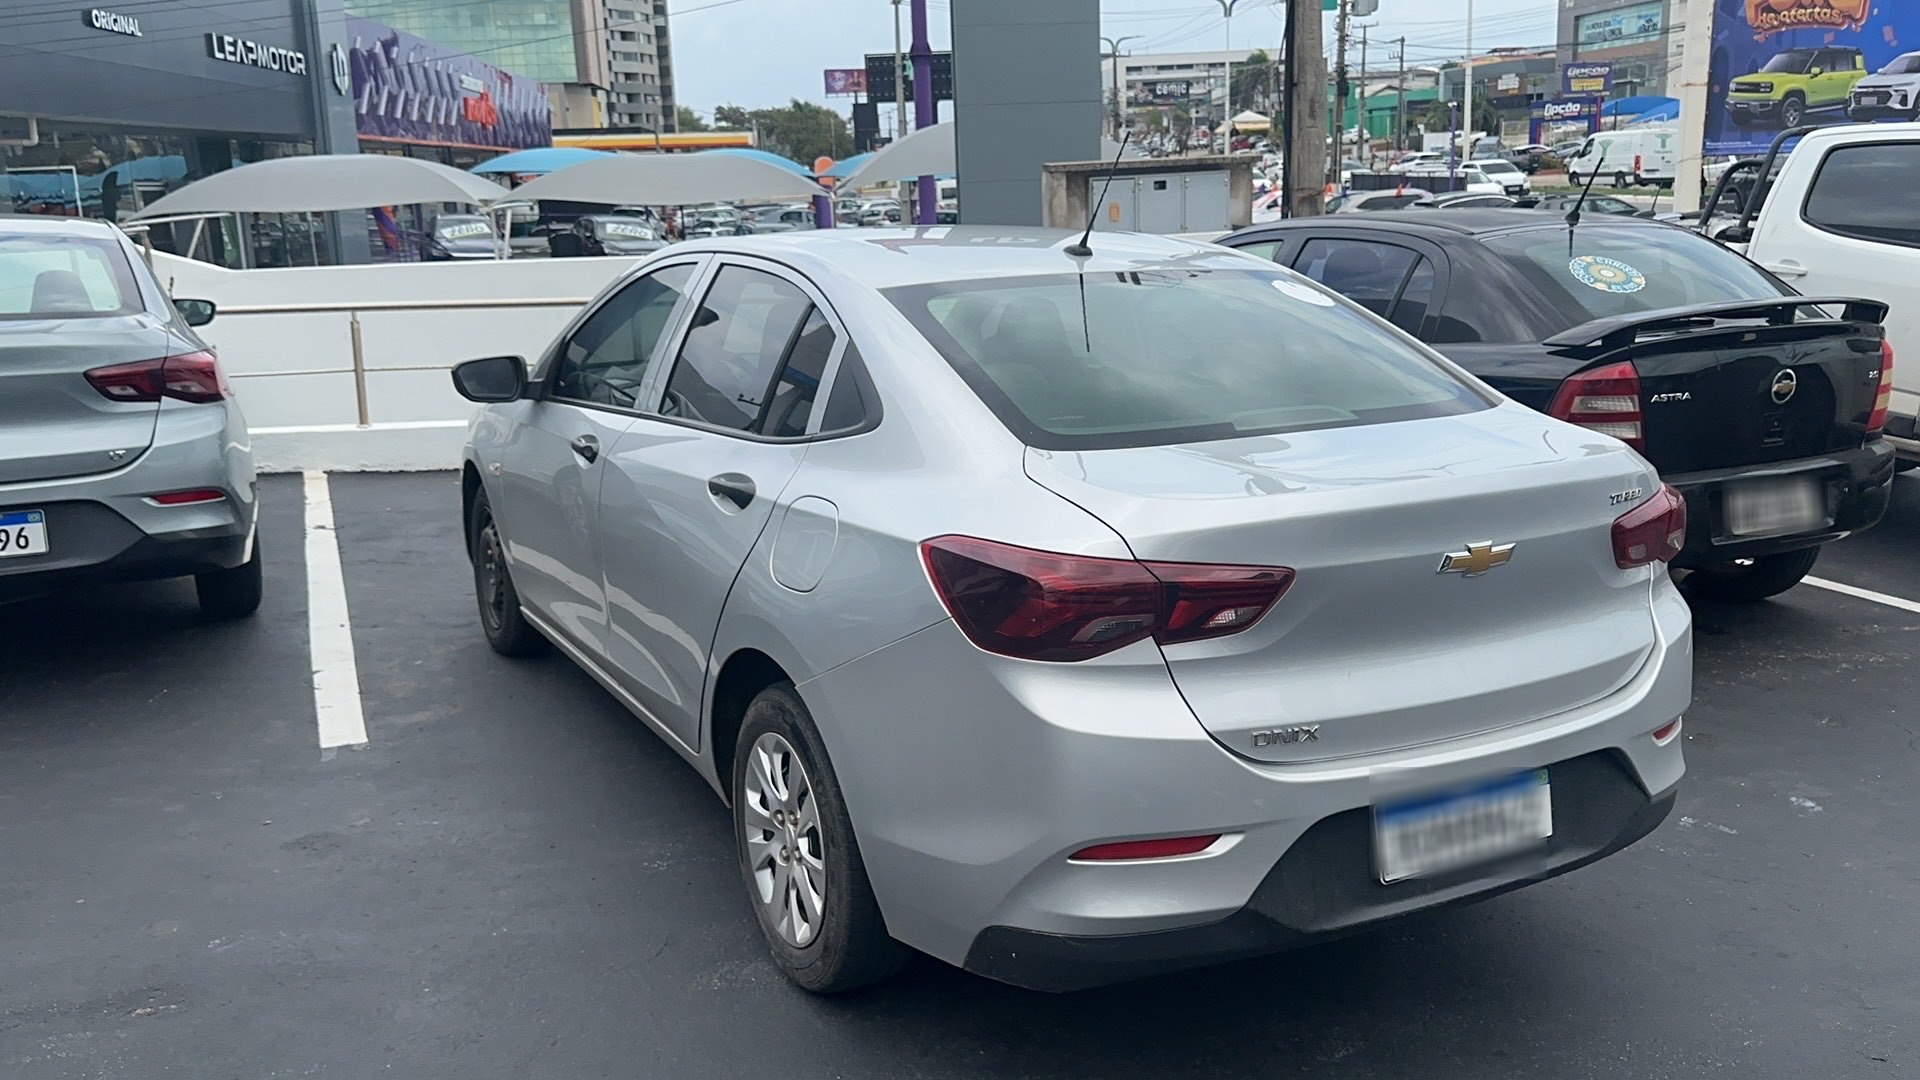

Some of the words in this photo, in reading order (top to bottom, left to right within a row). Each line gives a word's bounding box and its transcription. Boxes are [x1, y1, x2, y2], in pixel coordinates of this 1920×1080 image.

[211, 32, 307, 76] LEAPMOTOR
[1650, 391, 1692, 403] ASTRA
[1610, 487, 1642, 504] TURBO
[1251, 724, 1320, 748] ONIX
